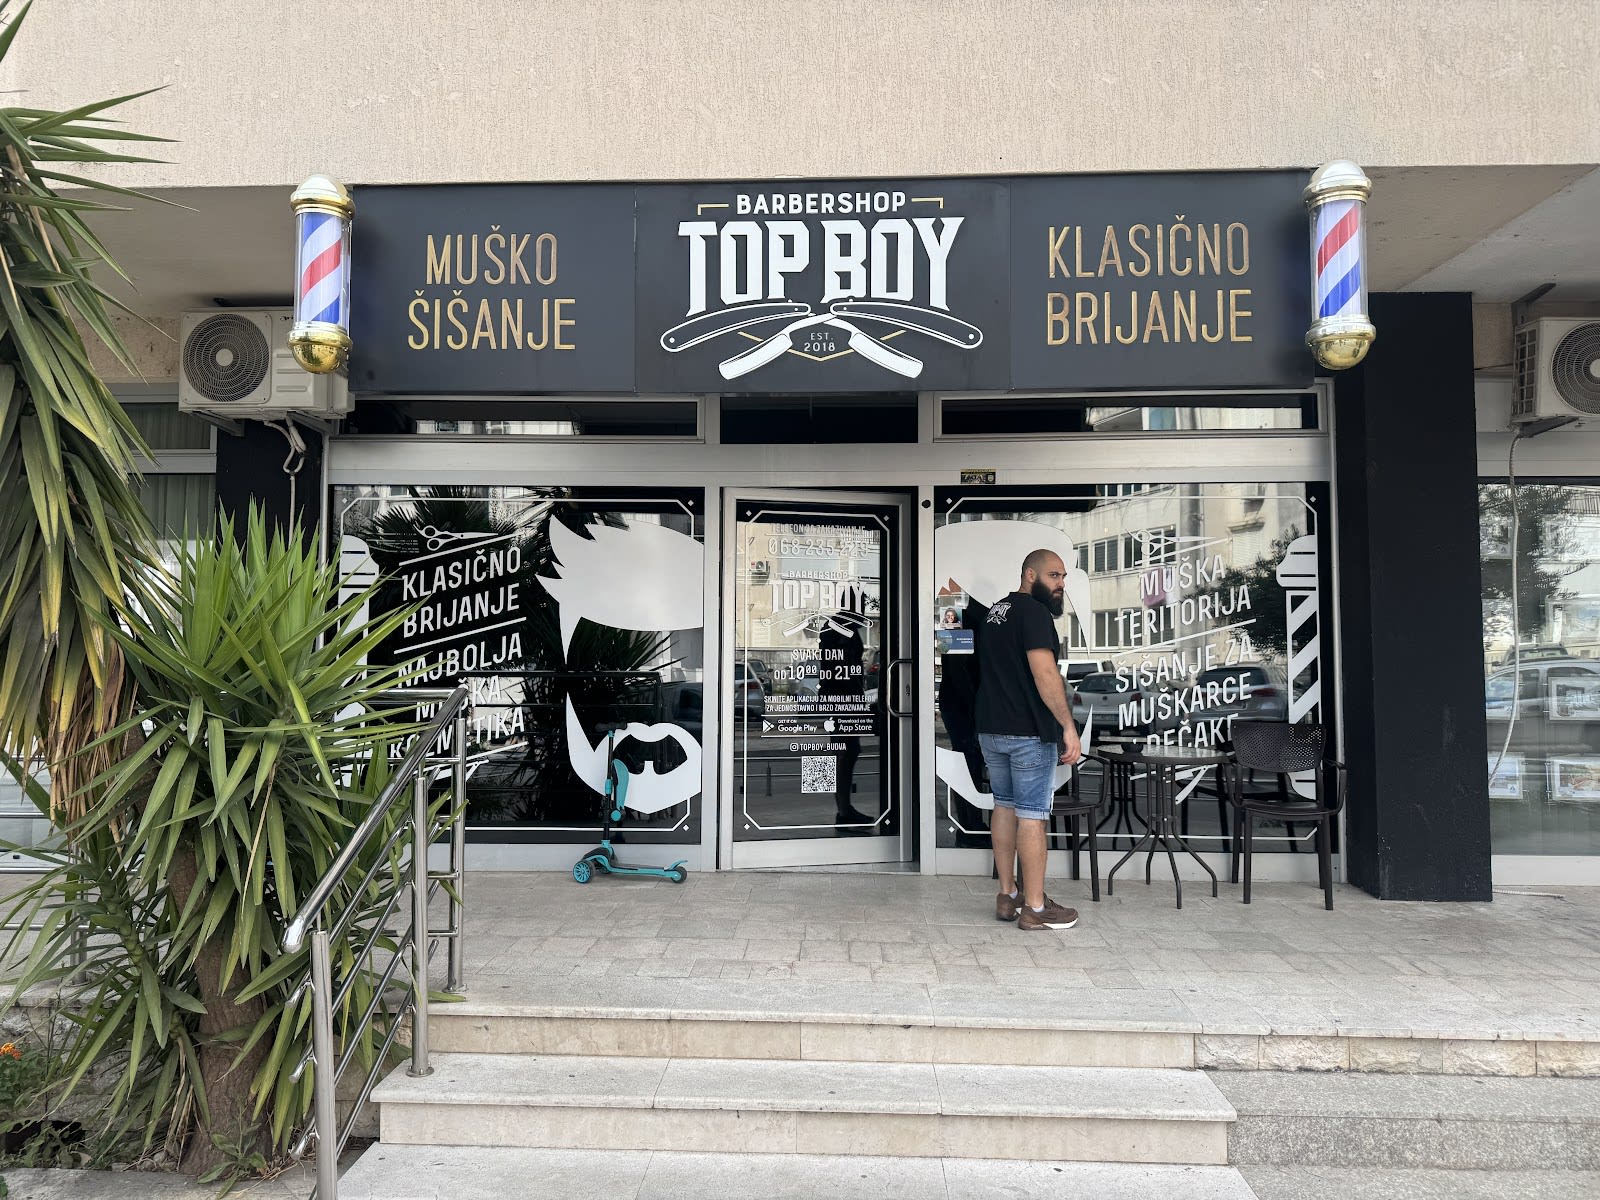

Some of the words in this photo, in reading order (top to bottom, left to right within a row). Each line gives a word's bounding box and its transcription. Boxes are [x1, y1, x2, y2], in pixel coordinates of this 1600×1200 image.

[736, 191, 906, 215] BARBERSHOP
[426, 224, 558, 285] MUŠKO
[677, 220, 810, 317] TOP
[819, 216, 966, 312] BOY
[1048, 214, 1250, 278] KLASIČNO
[407, 289, 576, 351] ŠIŠANJE
[810, 332, 834, 342] EST.
[1047, 288, 1253, 346] BRIJANJE
[803, 342, 836, 352] 2018
[401, 546, 521, 601] KLASIČNO
[770, 579, 815, 614] TOP
[819, 579, 867, 615] BOY
[1140, 553, 1226, 600] MUŠKA
[402, 582, 520, 639] BRIJANJE
[1114, 584, 1252, 643] TERITORIJA
[397, 632, 523, 689] NAJBOLJA
[773, 670, 787, 680] OD
[820, 670, 832, 680] DO
[791, 649, 823, 661] SVAKI
[824, 649, 844, 660] DAN
[1115, 643, 1219, 693] ŠIŠANJE
[1225, 634, 1254, 667] ZA
[763, 695, 786, 703] SKINITE
[786, 695, 819, 703] APLIKACIJU
[852, 694, 876, 702] TELEFON
[774, 704, 815, 712] JEDNOSTAVNO
[1118, 671, 1252, 731] MUŠKARCE
[777, 724, 803, 733] Google
[803, 724, 817, 733] Play
[838, 724, 854, 732] App
[854, 723, 873, 731] Store
